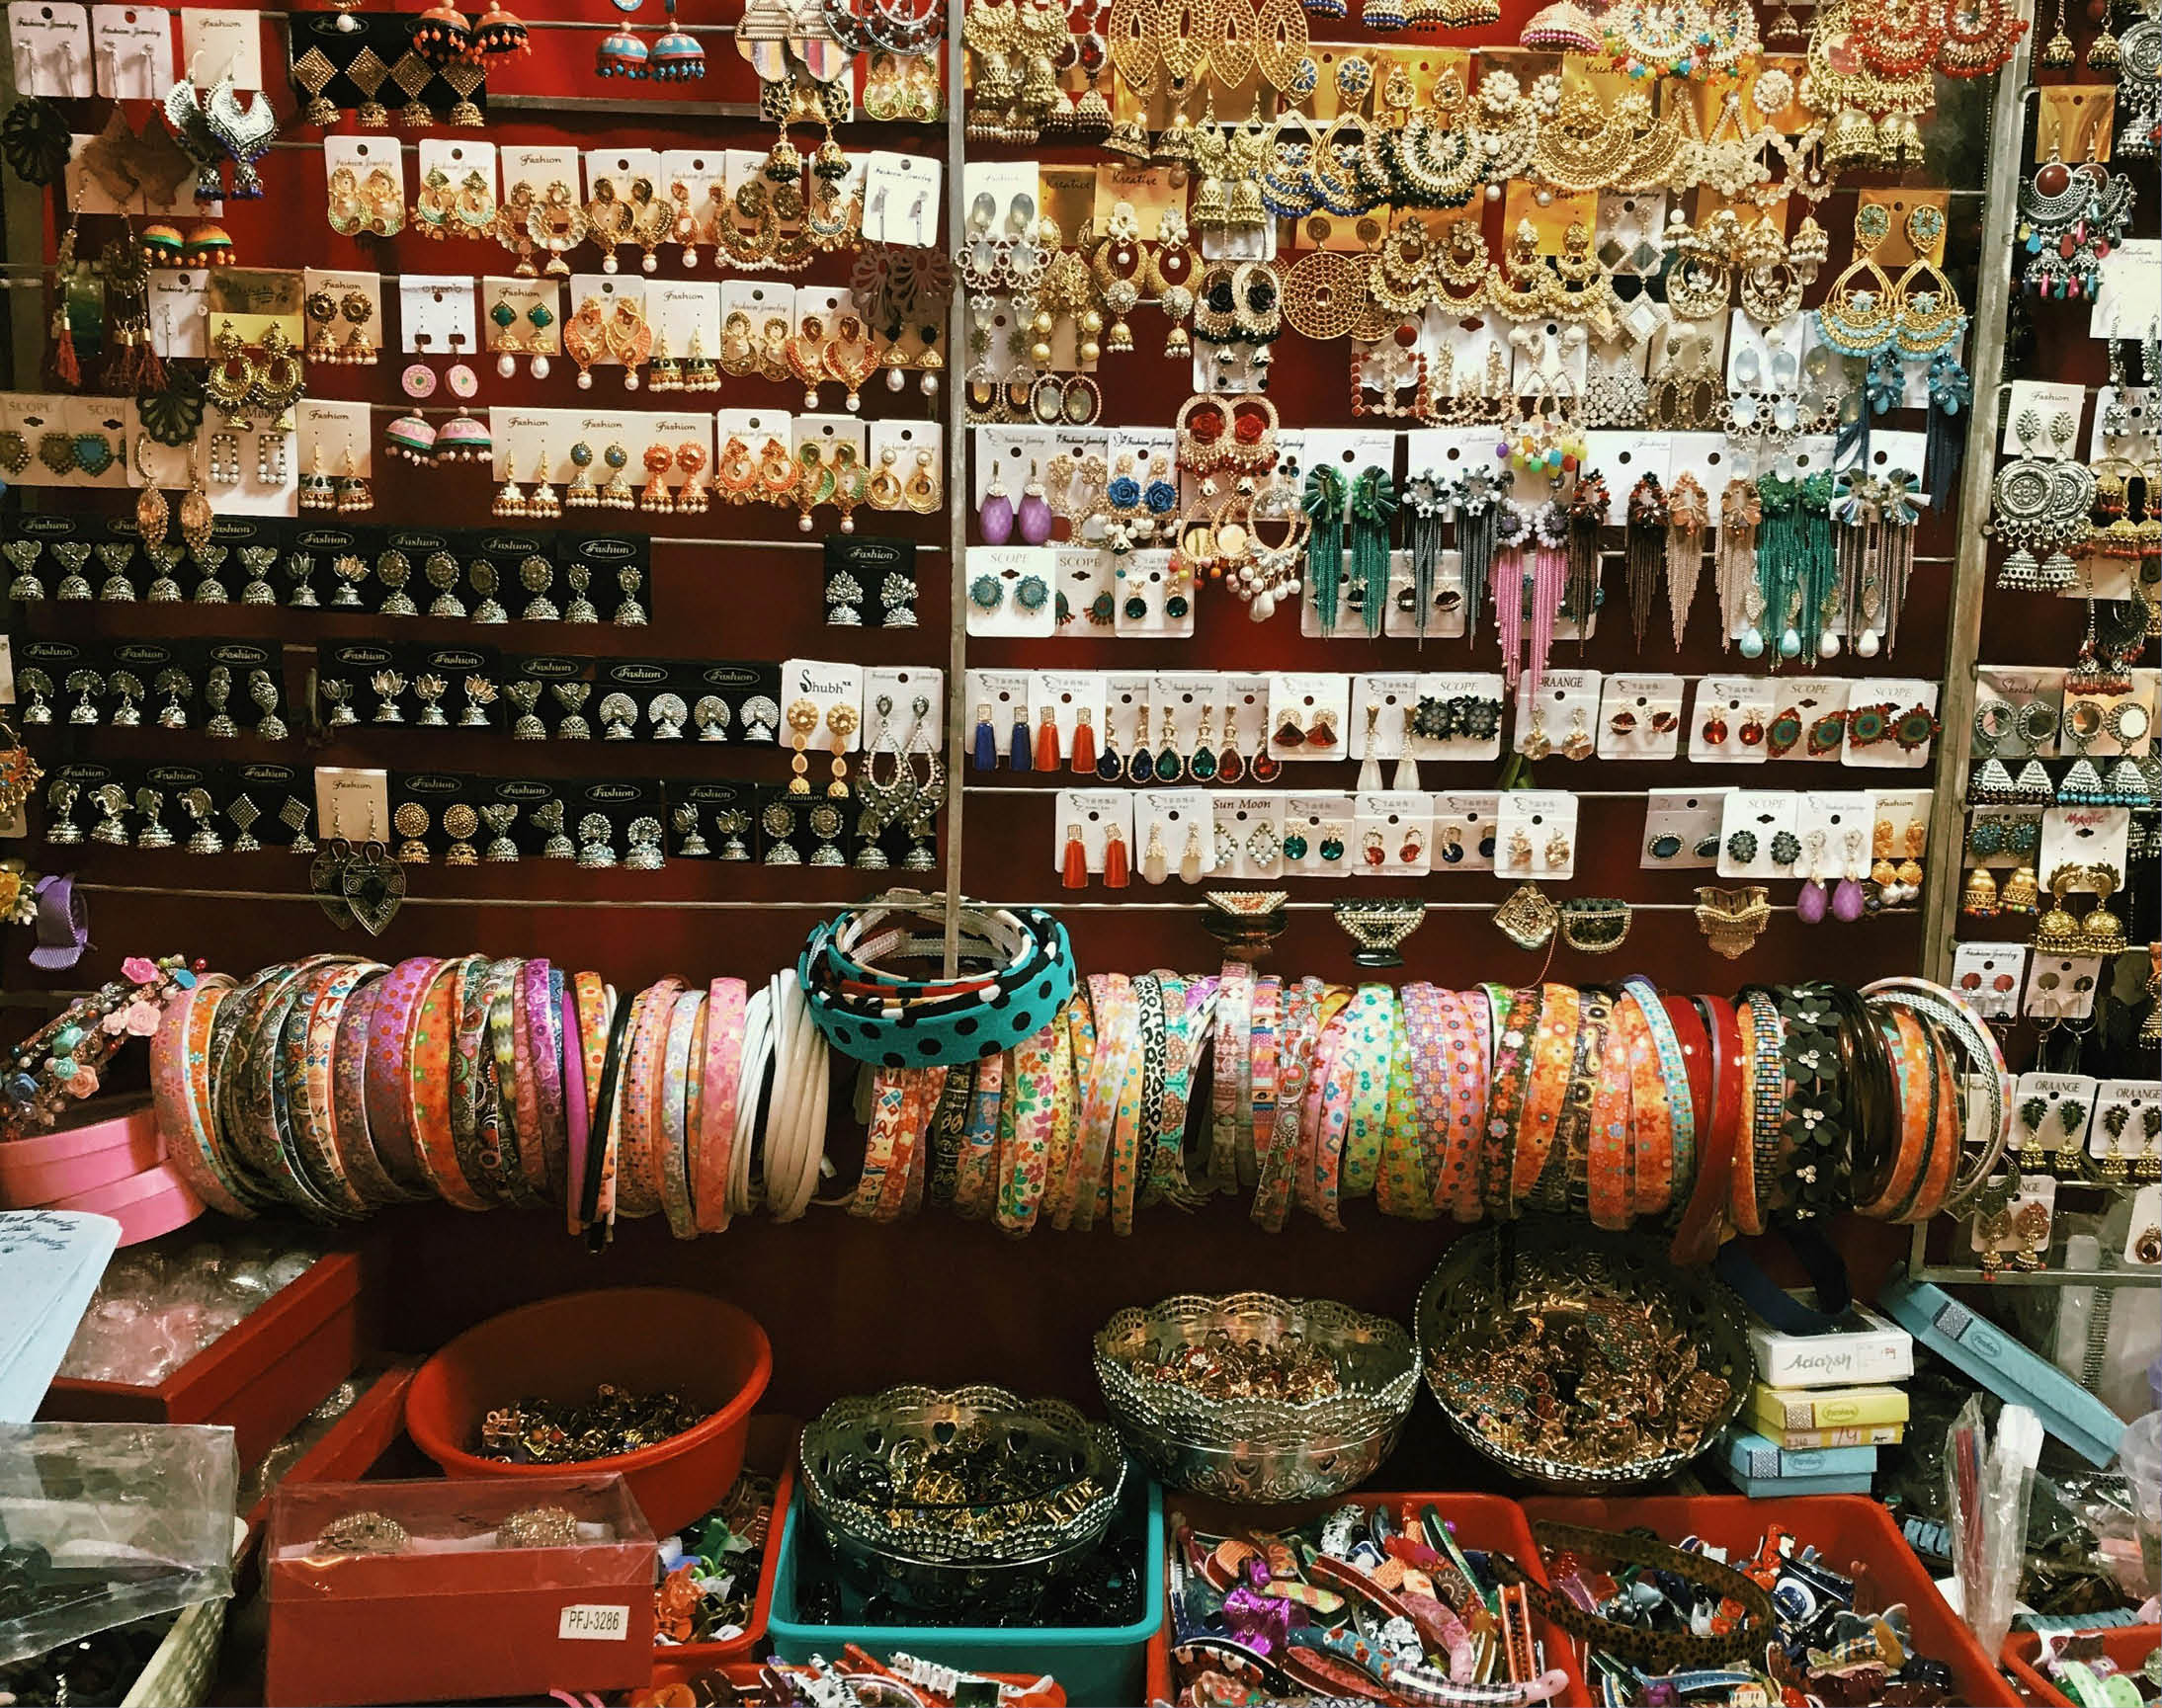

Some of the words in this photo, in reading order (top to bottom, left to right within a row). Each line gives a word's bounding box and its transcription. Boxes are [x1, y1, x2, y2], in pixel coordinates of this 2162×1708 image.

[519, 154, 562, 166] Fashion
[1112, 172, 1157, 187] Kreative
[320, 279, 362, 290] Fashion
[498, 286, 540, 298] Fashion
[663, 290, 704, 302] Fashion
[2030, 390, 2070, 402] Fashion
[308, 410, 349, 421] Fashion
[507, 417, 548, 428] Fashion
[582, 418, 623, 429] Fashion
[655, 421, 697, 432] Fashion
[306, 533, 347, 544] Fashion
[850, 549, 893, 560] Fashion
[1059, 556, 1101, 567] SCOPE
[218, 650, 261, 661] Fashion
[435, 654, 478, 665] Fashion
[618, 669, 661, 680] Fashion
[710, 672, 753, 683] Fashion
[799, 669, 843, 694] Shubh
[1439, 681, 1478, 691] SCOPE
[1790, 684, 1829, 694] SCOPE
[1873, 687, 1913, 697] SCOPE
[592, 786, 635, 798] Fashion
[1213, 798, 1234, 810] Sun
[1238, 797, 1272, 810] Moon
[1877, 798, 1914, 810] Fashion
[2036, 1080, 2080, 1093] ORAANGE
[1783, 1352, 1852, 1374] Adarsh
[568, 1610, 620, 1630] PFJ-3286
